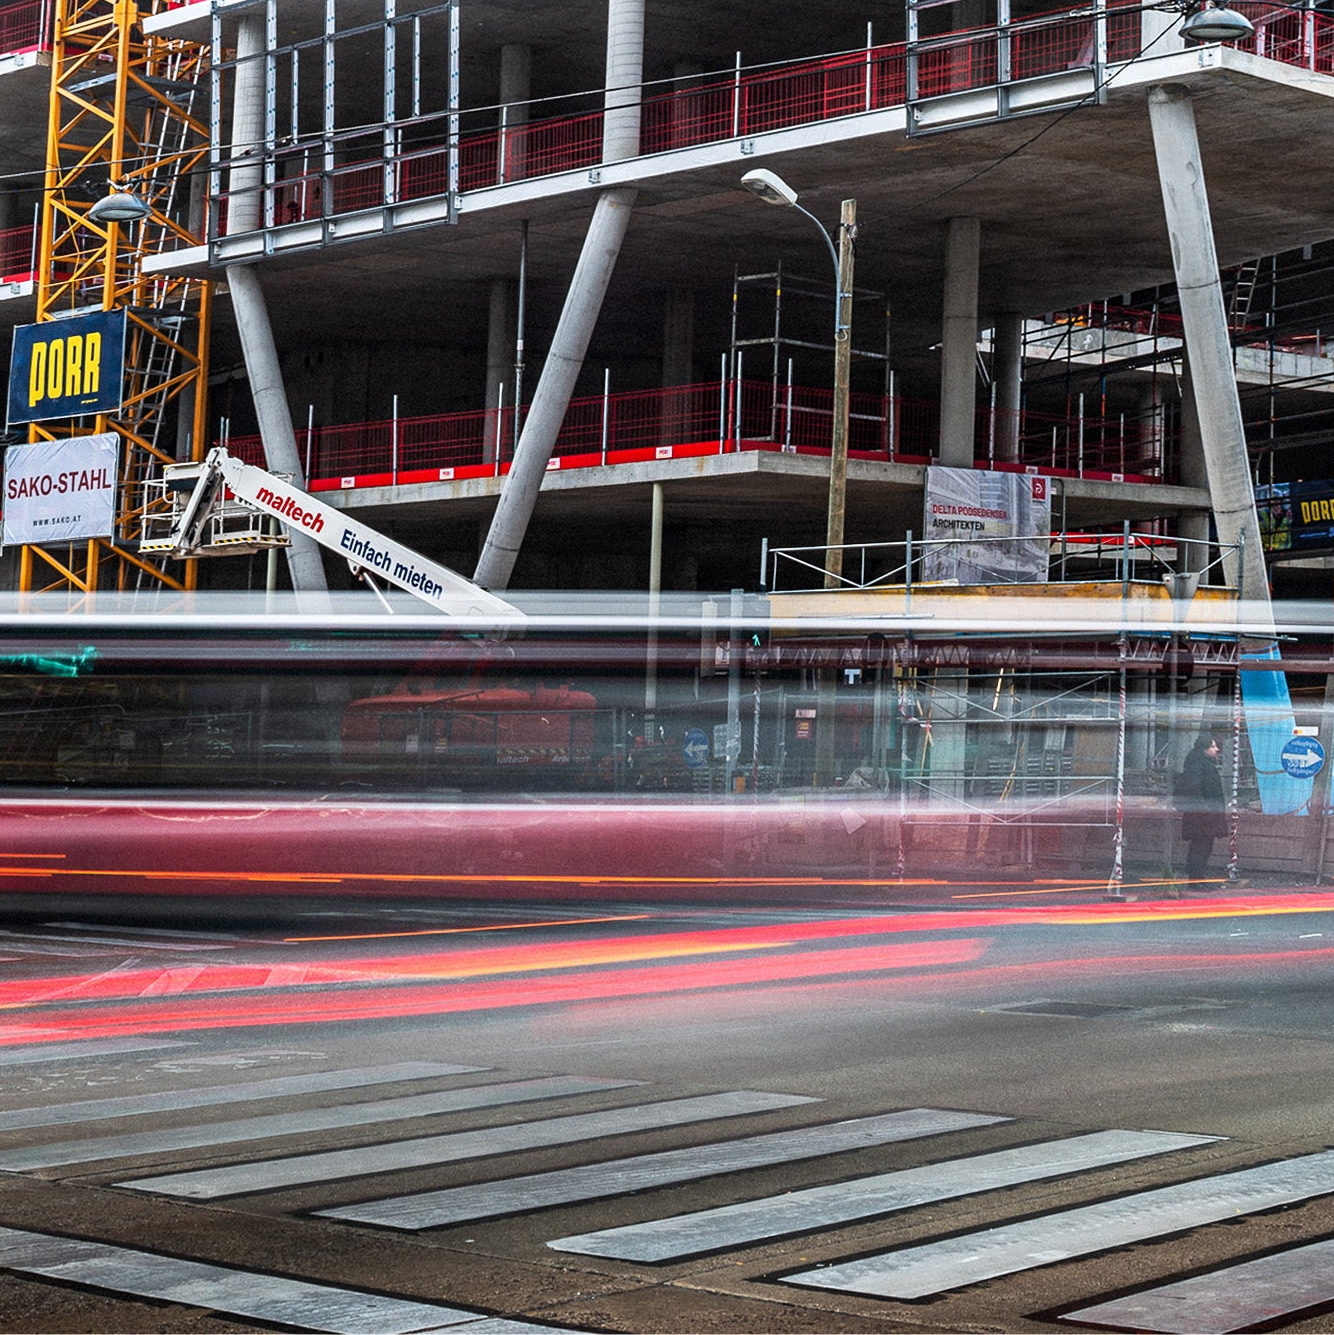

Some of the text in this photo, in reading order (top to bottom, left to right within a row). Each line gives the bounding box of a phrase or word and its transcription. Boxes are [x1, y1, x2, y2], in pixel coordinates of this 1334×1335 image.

[28, 331, 102, 408] PORR
[7, 468, 112, 500] SAKO-STAHL
[33, 515, 82, 527] WWW.SAKO.AT
[255, 486, 325, 534] maltech
[932, 504, 957, 515] DELTA
[932, 517, 985, 531] ARCHITEKTEN
[340, 528, 443, 601] Einfach mieten
